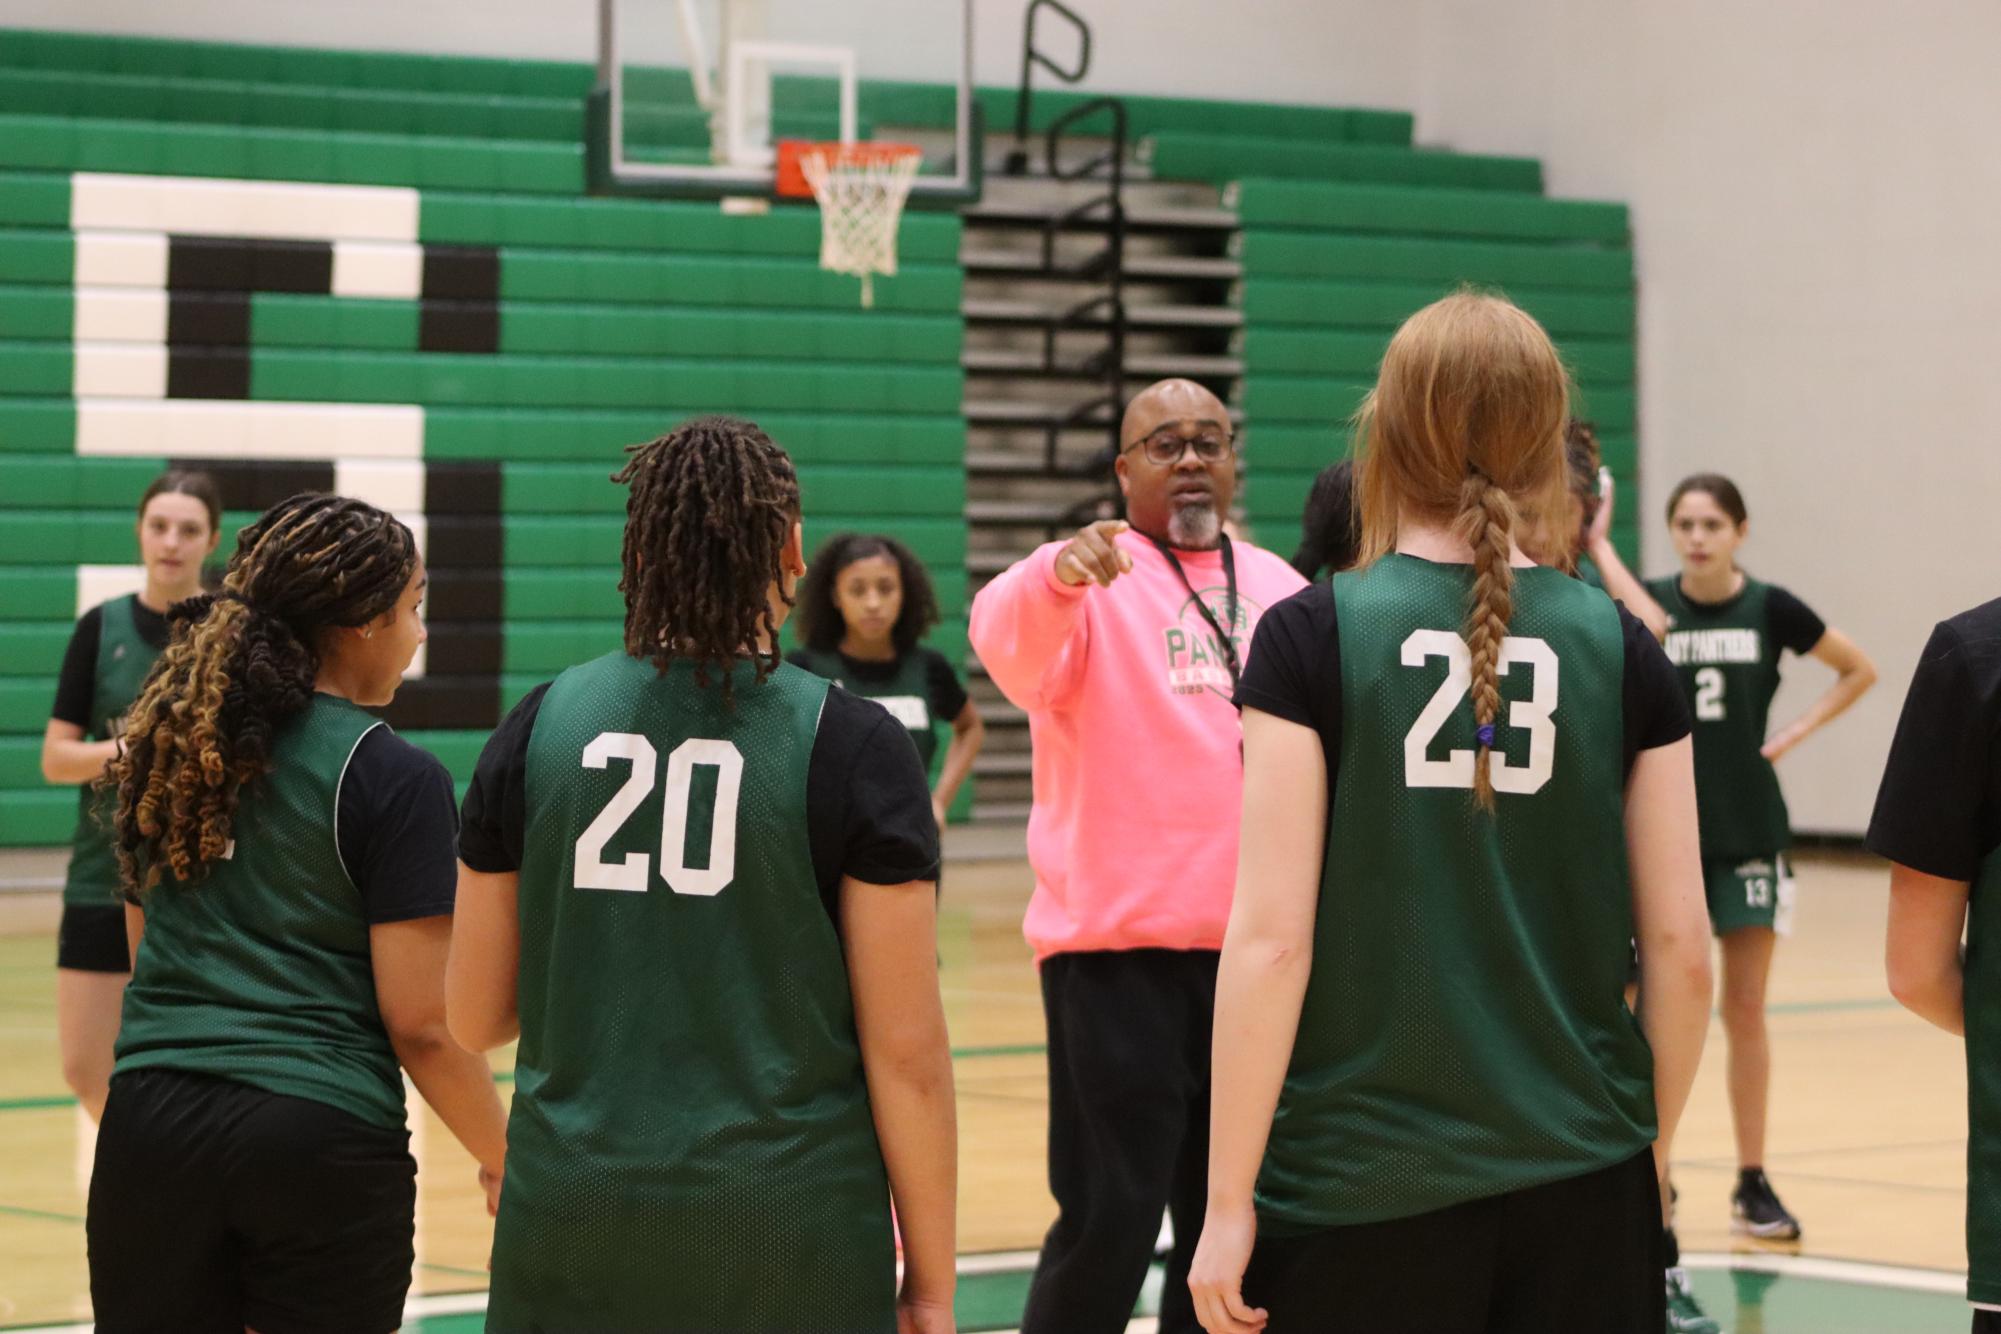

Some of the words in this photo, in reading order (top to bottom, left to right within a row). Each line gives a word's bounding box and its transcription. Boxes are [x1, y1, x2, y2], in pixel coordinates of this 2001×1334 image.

[1401, 629, 1559, 795] 23
[1695, 667, 1725, 721] 2
[573, 732, 744, 896] 20
[1745, 878, 1771, 908] 13
